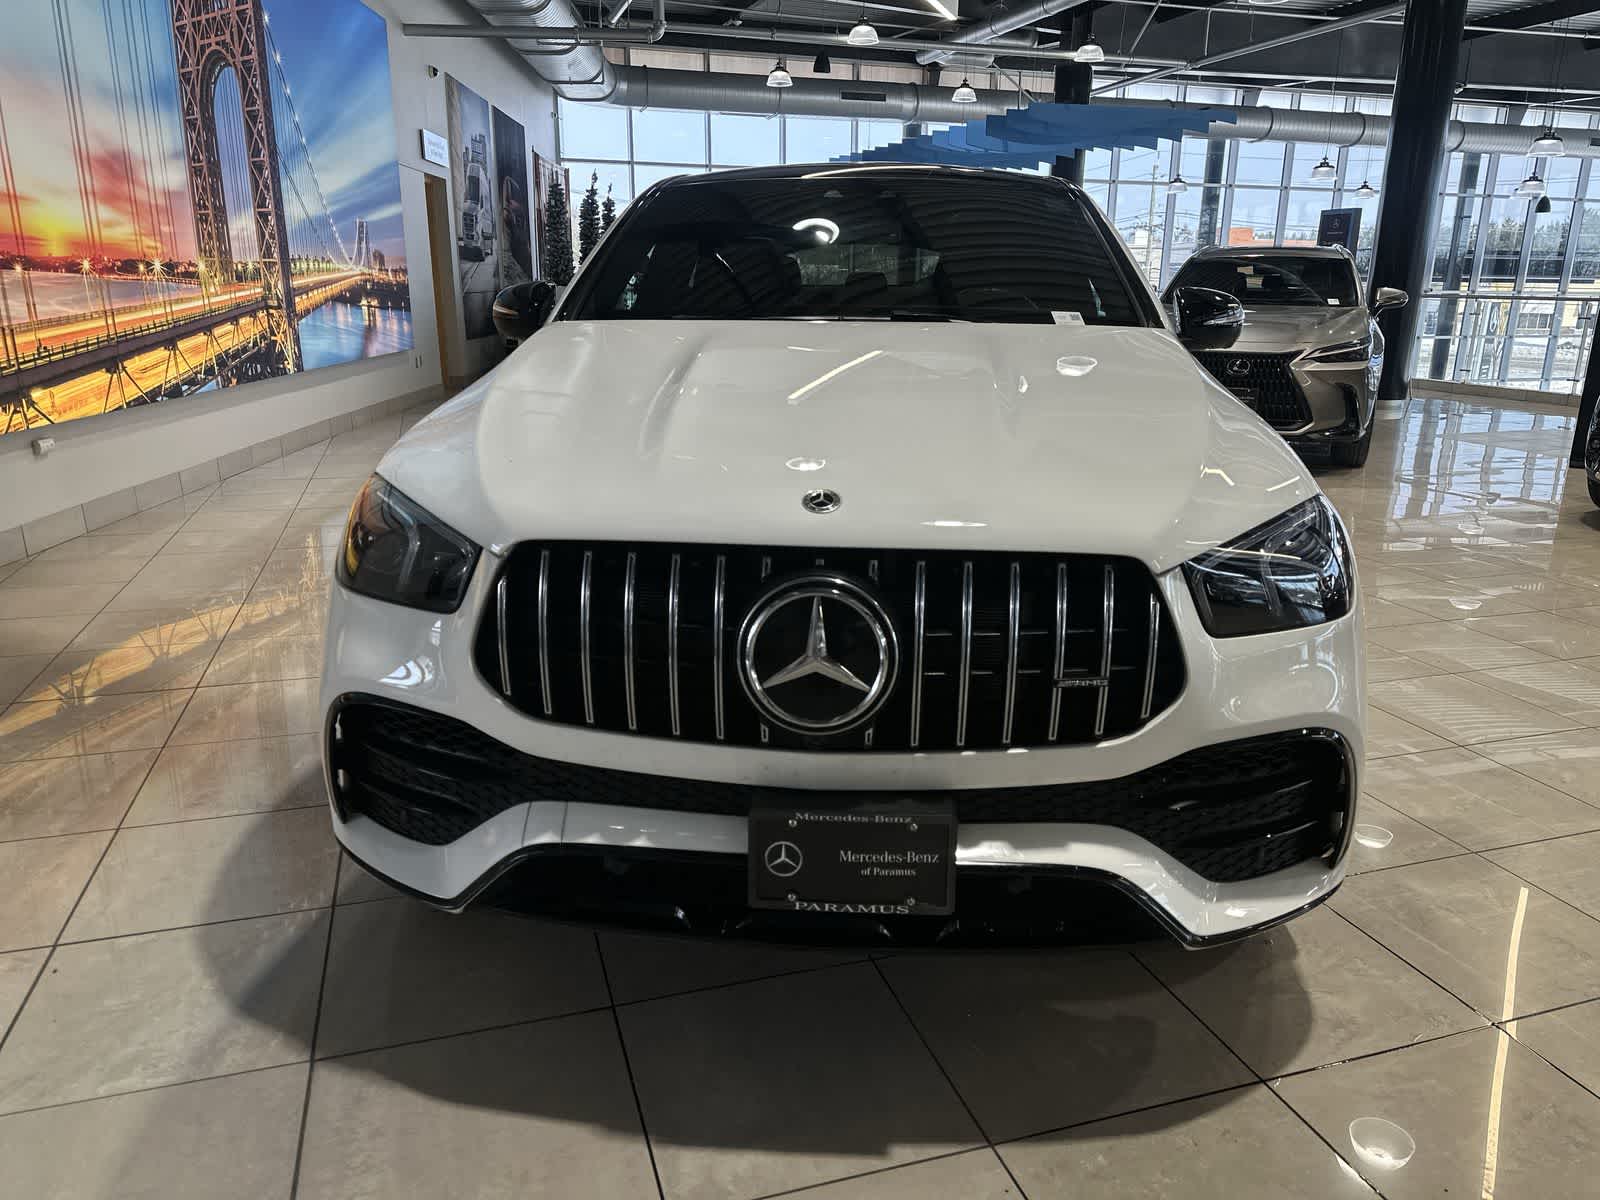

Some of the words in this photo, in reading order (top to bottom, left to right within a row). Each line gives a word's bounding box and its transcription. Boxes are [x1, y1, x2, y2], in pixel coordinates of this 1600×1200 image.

[795, 812, 912, 824] Mercedes-Benz
[839, 850, 940, 864] Mercedes-Benz
[860, 867, 872, 876] of
[873, 867, 916, 877] Paramus
[794, 902, 909, 914] PARAMUS
